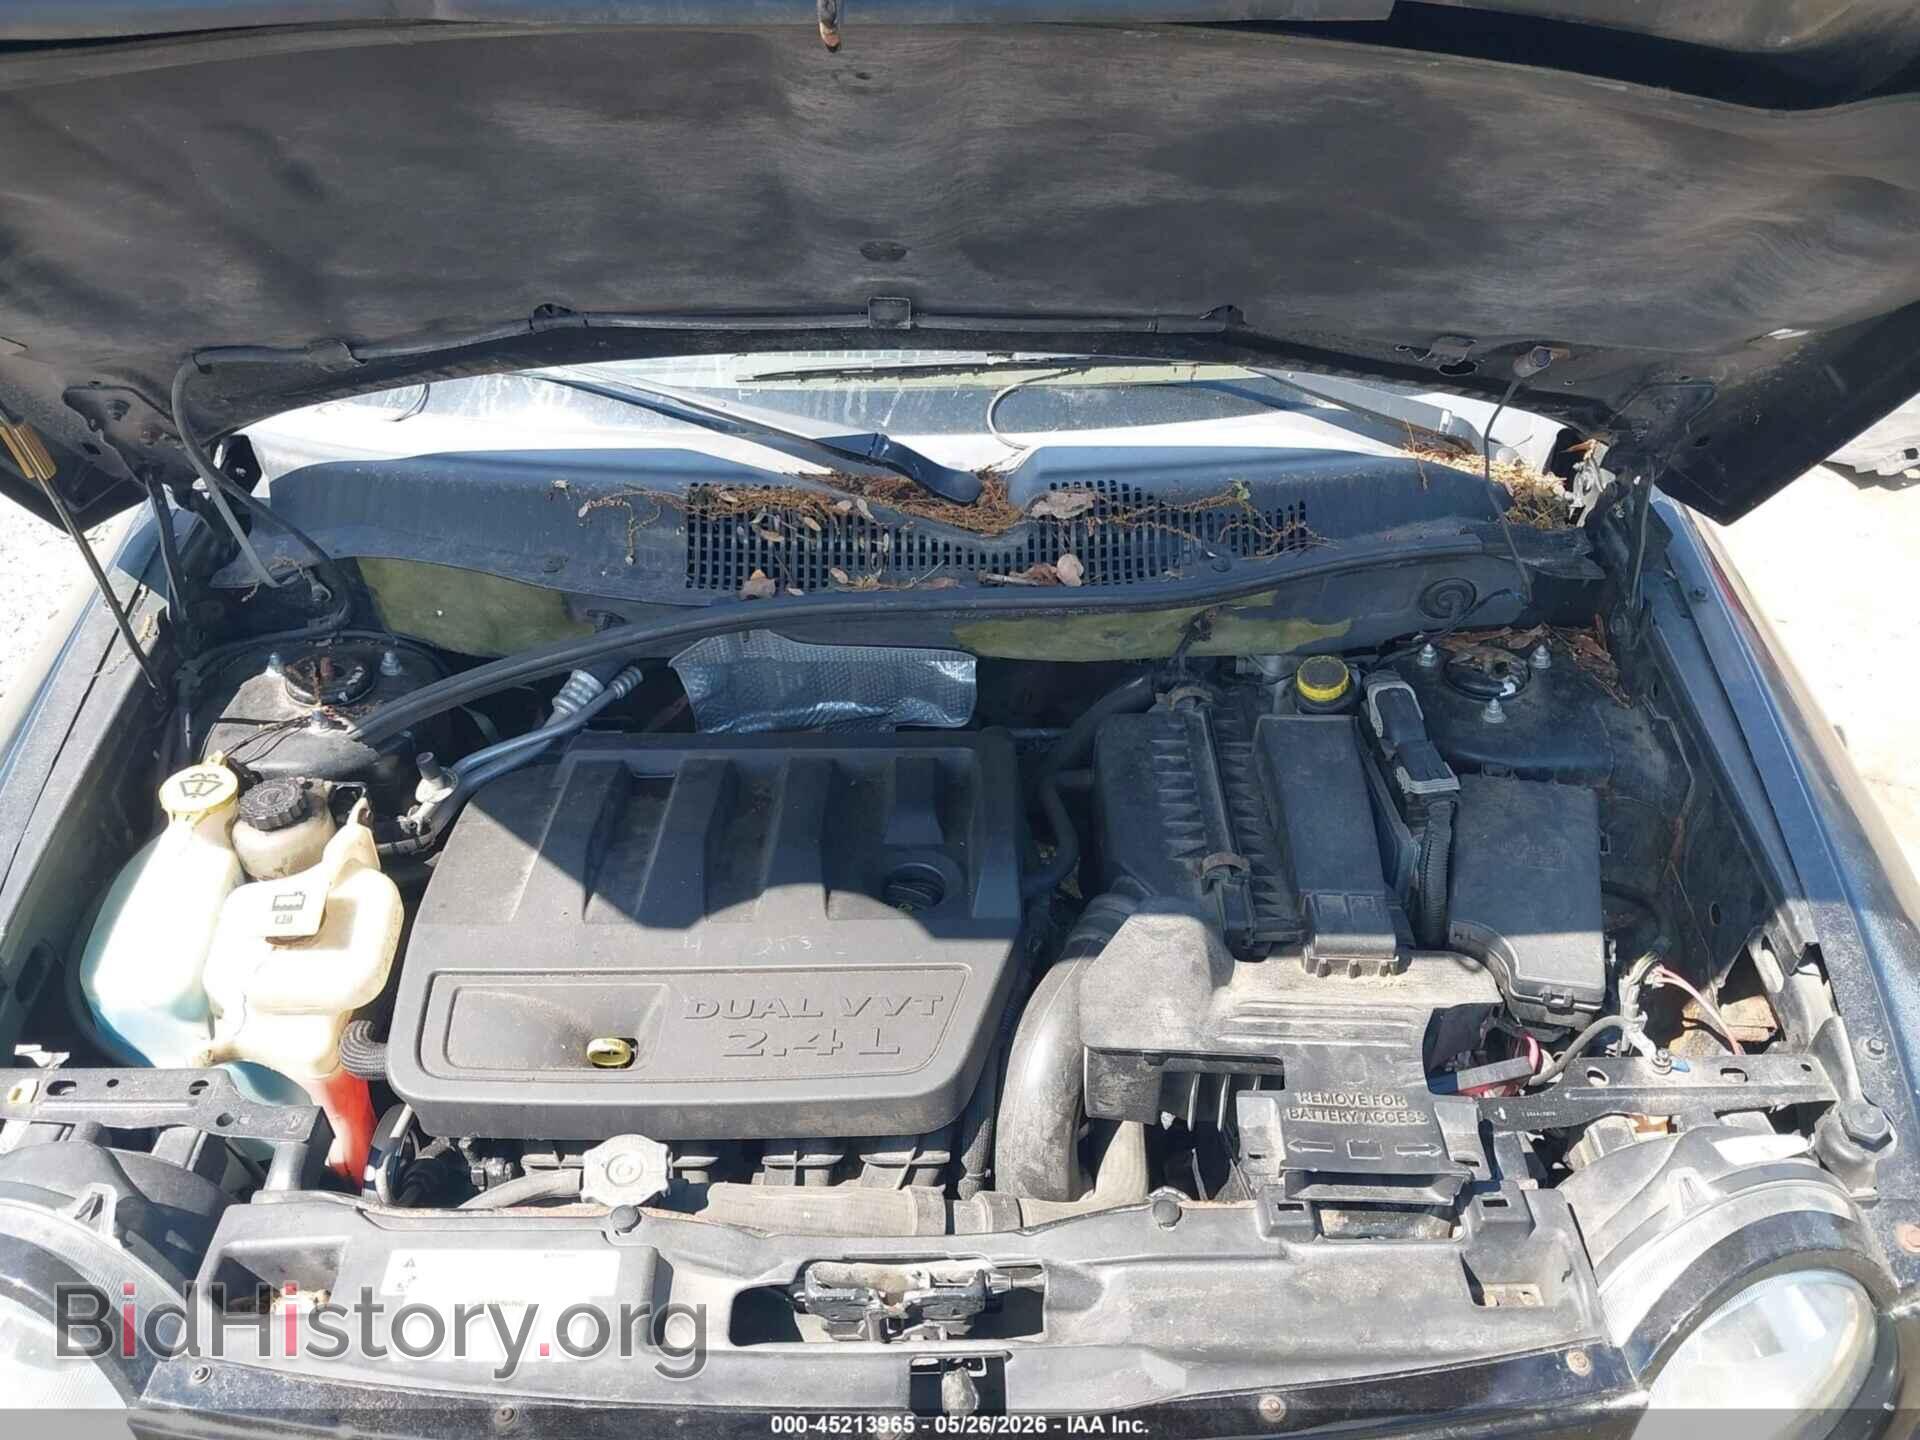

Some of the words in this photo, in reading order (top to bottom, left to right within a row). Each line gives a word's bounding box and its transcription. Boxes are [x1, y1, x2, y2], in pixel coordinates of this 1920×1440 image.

[682, 997, 824, 1020] DUAL
[838, 995, 944, 1017] VVT
[1297, 1091, 1369, 1106] REMOVE
[1373, 1093, 1407, 1107] FOR
[1289, 1107, 1358, 1122] BATTERY
[1363, 1110, 1429, 1124] ACCESS
